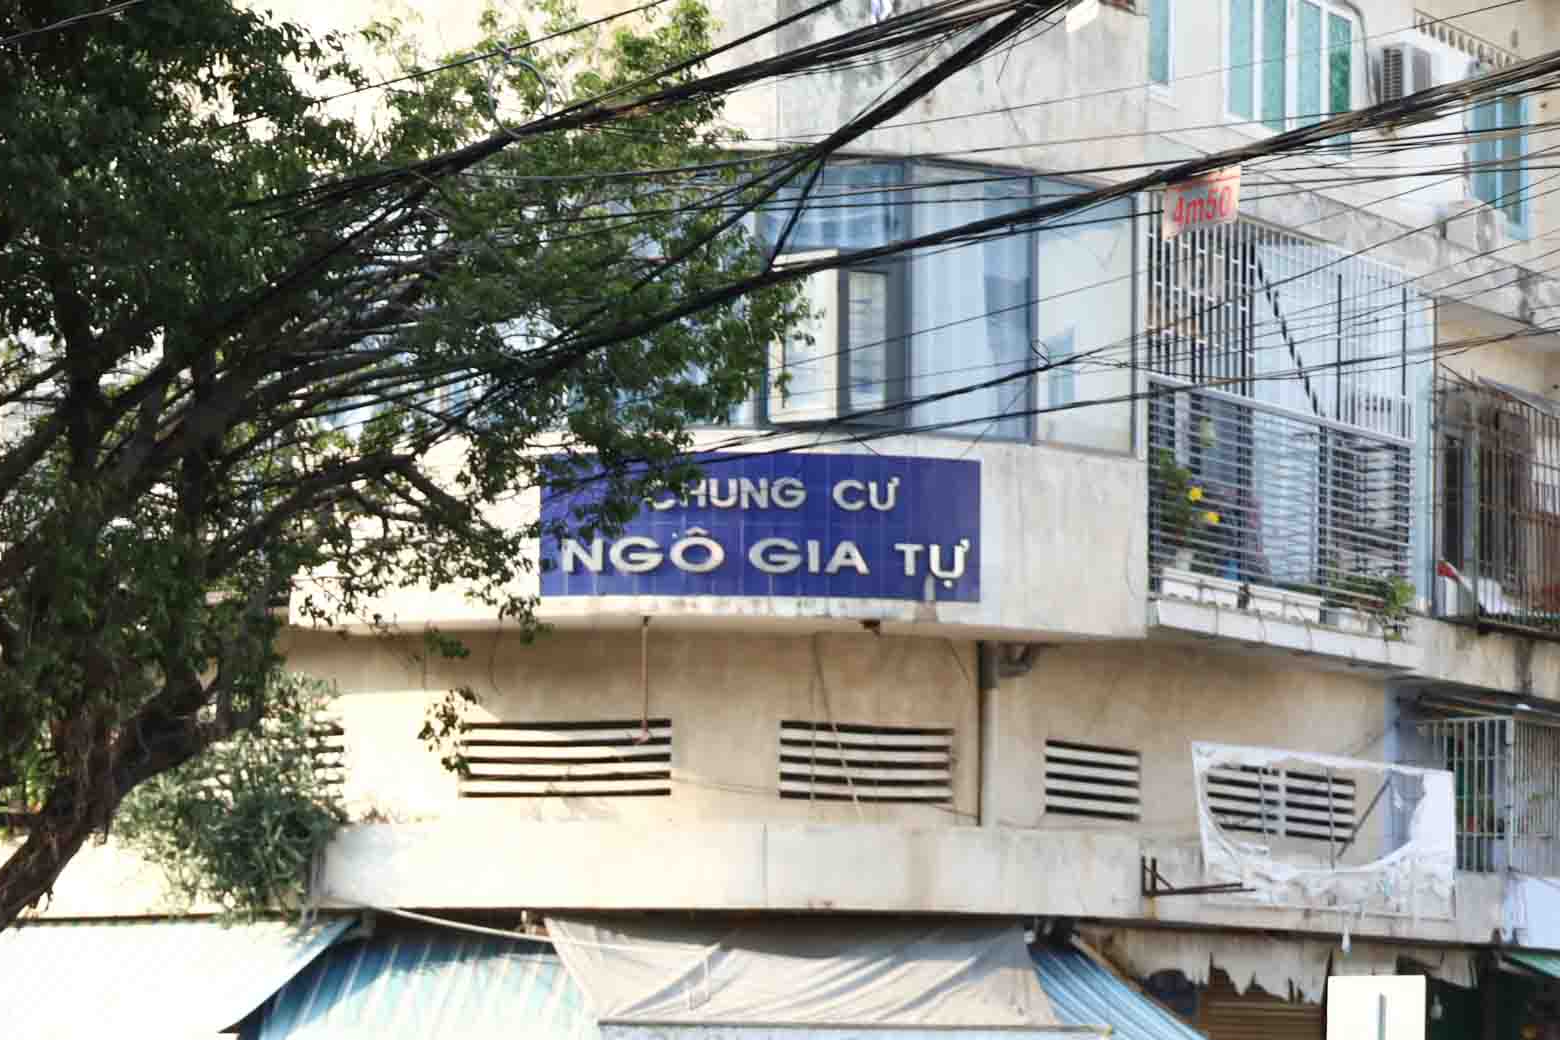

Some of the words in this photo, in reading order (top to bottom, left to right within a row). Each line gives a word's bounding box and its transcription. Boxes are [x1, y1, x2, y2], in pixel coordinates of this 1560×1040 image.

[643, 476, 807, 511] CHUNG
[832, 477, 899, 512] CƯ
[559, 528, 724, 574] NGÔ
[748, 537, 869, 576] GIA
[895, 538, 970, 588] TỰ
